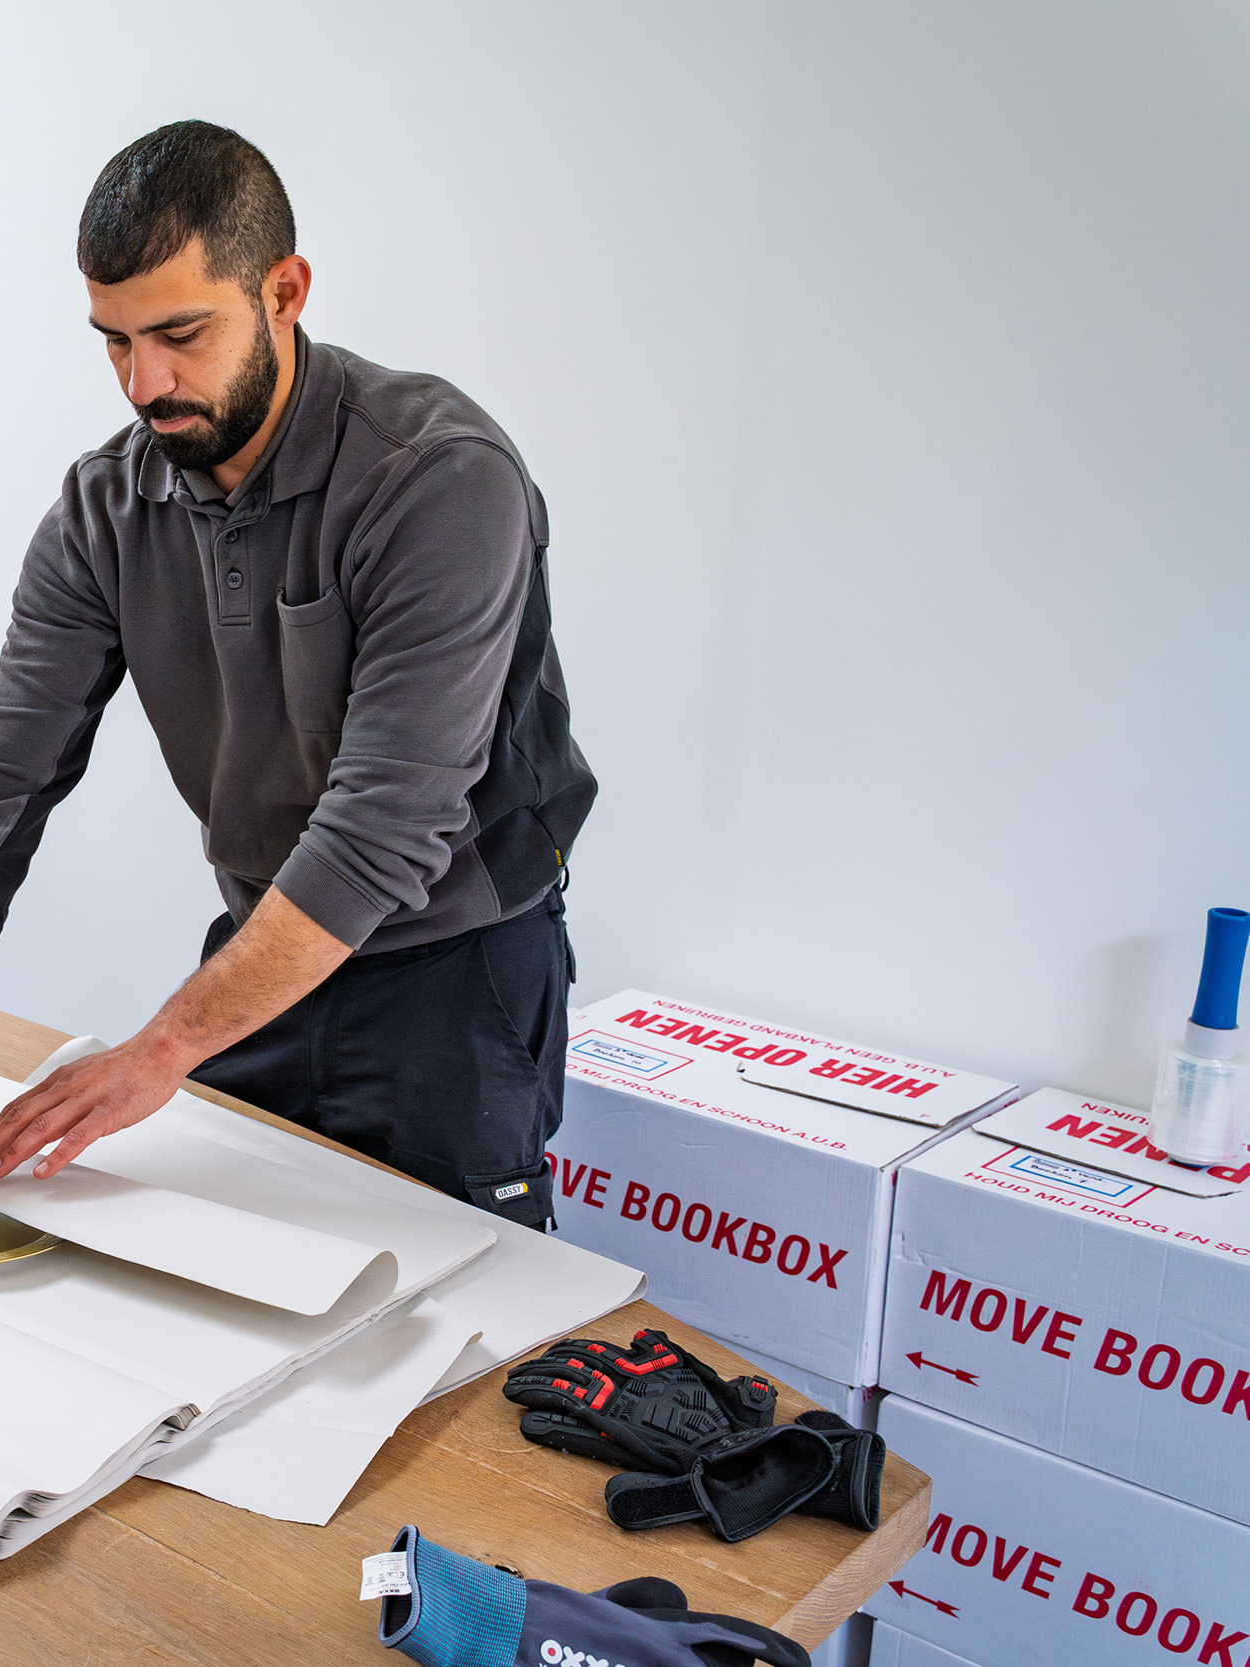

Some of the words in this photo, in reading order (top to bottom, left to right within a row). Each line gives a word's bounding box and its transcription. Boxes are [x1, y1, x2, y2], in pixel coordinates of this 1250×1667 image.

[652, 999, 748, 1028] GEBRUIKEN
[614, 1009, 808, 1067] OPENEN
[749, 1023, 846, 1052] PLAKBAND
[848, 1047, 897, 1065] GEEN
[903, 1061, 957, 1079] A.U.B.
[808, 1058, 939, 1099] HIER
[579, 1067, 610, 1081] MIJ
[611, 1078, 677, 1100] DROOG
[679, 1097, 705, 1109] EN
[707, 1106, 791, 1133] SCHOON
[791, 1129, 847, 1151] A.U.B.
[1081, 1102, 1150, 1126] UIKEN
[497, 1184, 521, 1198] DASSY
[964, 1171, 1031, 1194] HOUD
[1034, 1191, 1077, 1208] MIJ
[1080, 1204, 1170, 1234] DROOG
[1173, 1230, 1211, 1245] EN
[620, 1180, 849, 1290] BOOKBOX
[919, 1269, 1083, 1360] MOVE
[1071, 1571, 1250, 1667] BOOK
[540, 1639, 627, 1667] OXX
